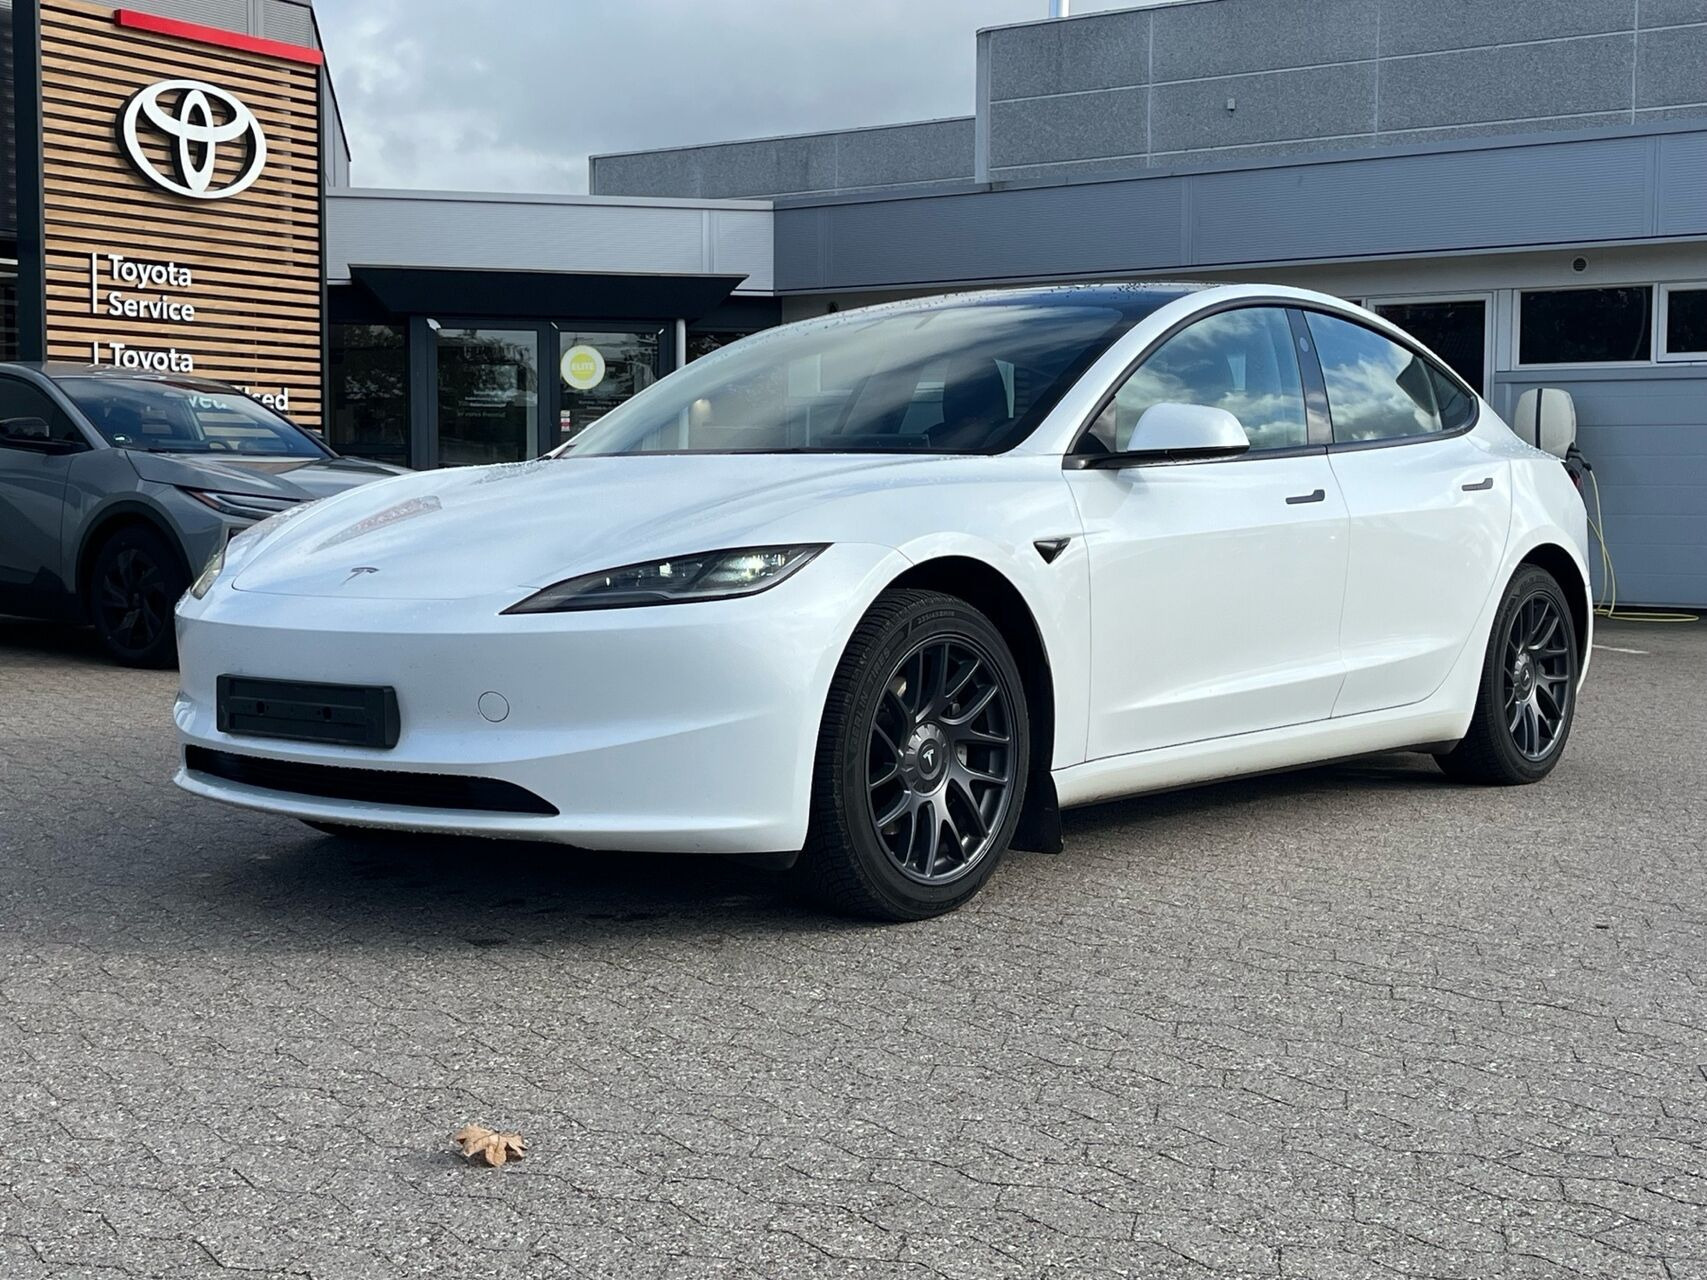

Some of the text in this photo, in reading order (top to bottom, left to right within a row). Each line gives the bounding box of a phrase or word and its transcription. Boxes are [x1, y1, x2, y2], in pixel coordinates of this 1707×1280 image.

[107, 254, 192, 289] Toyota
[108, 291, 196, 322] Service
[109, 342, 194, 373] Toyota
[571, 361, 594, 371] ELITE
